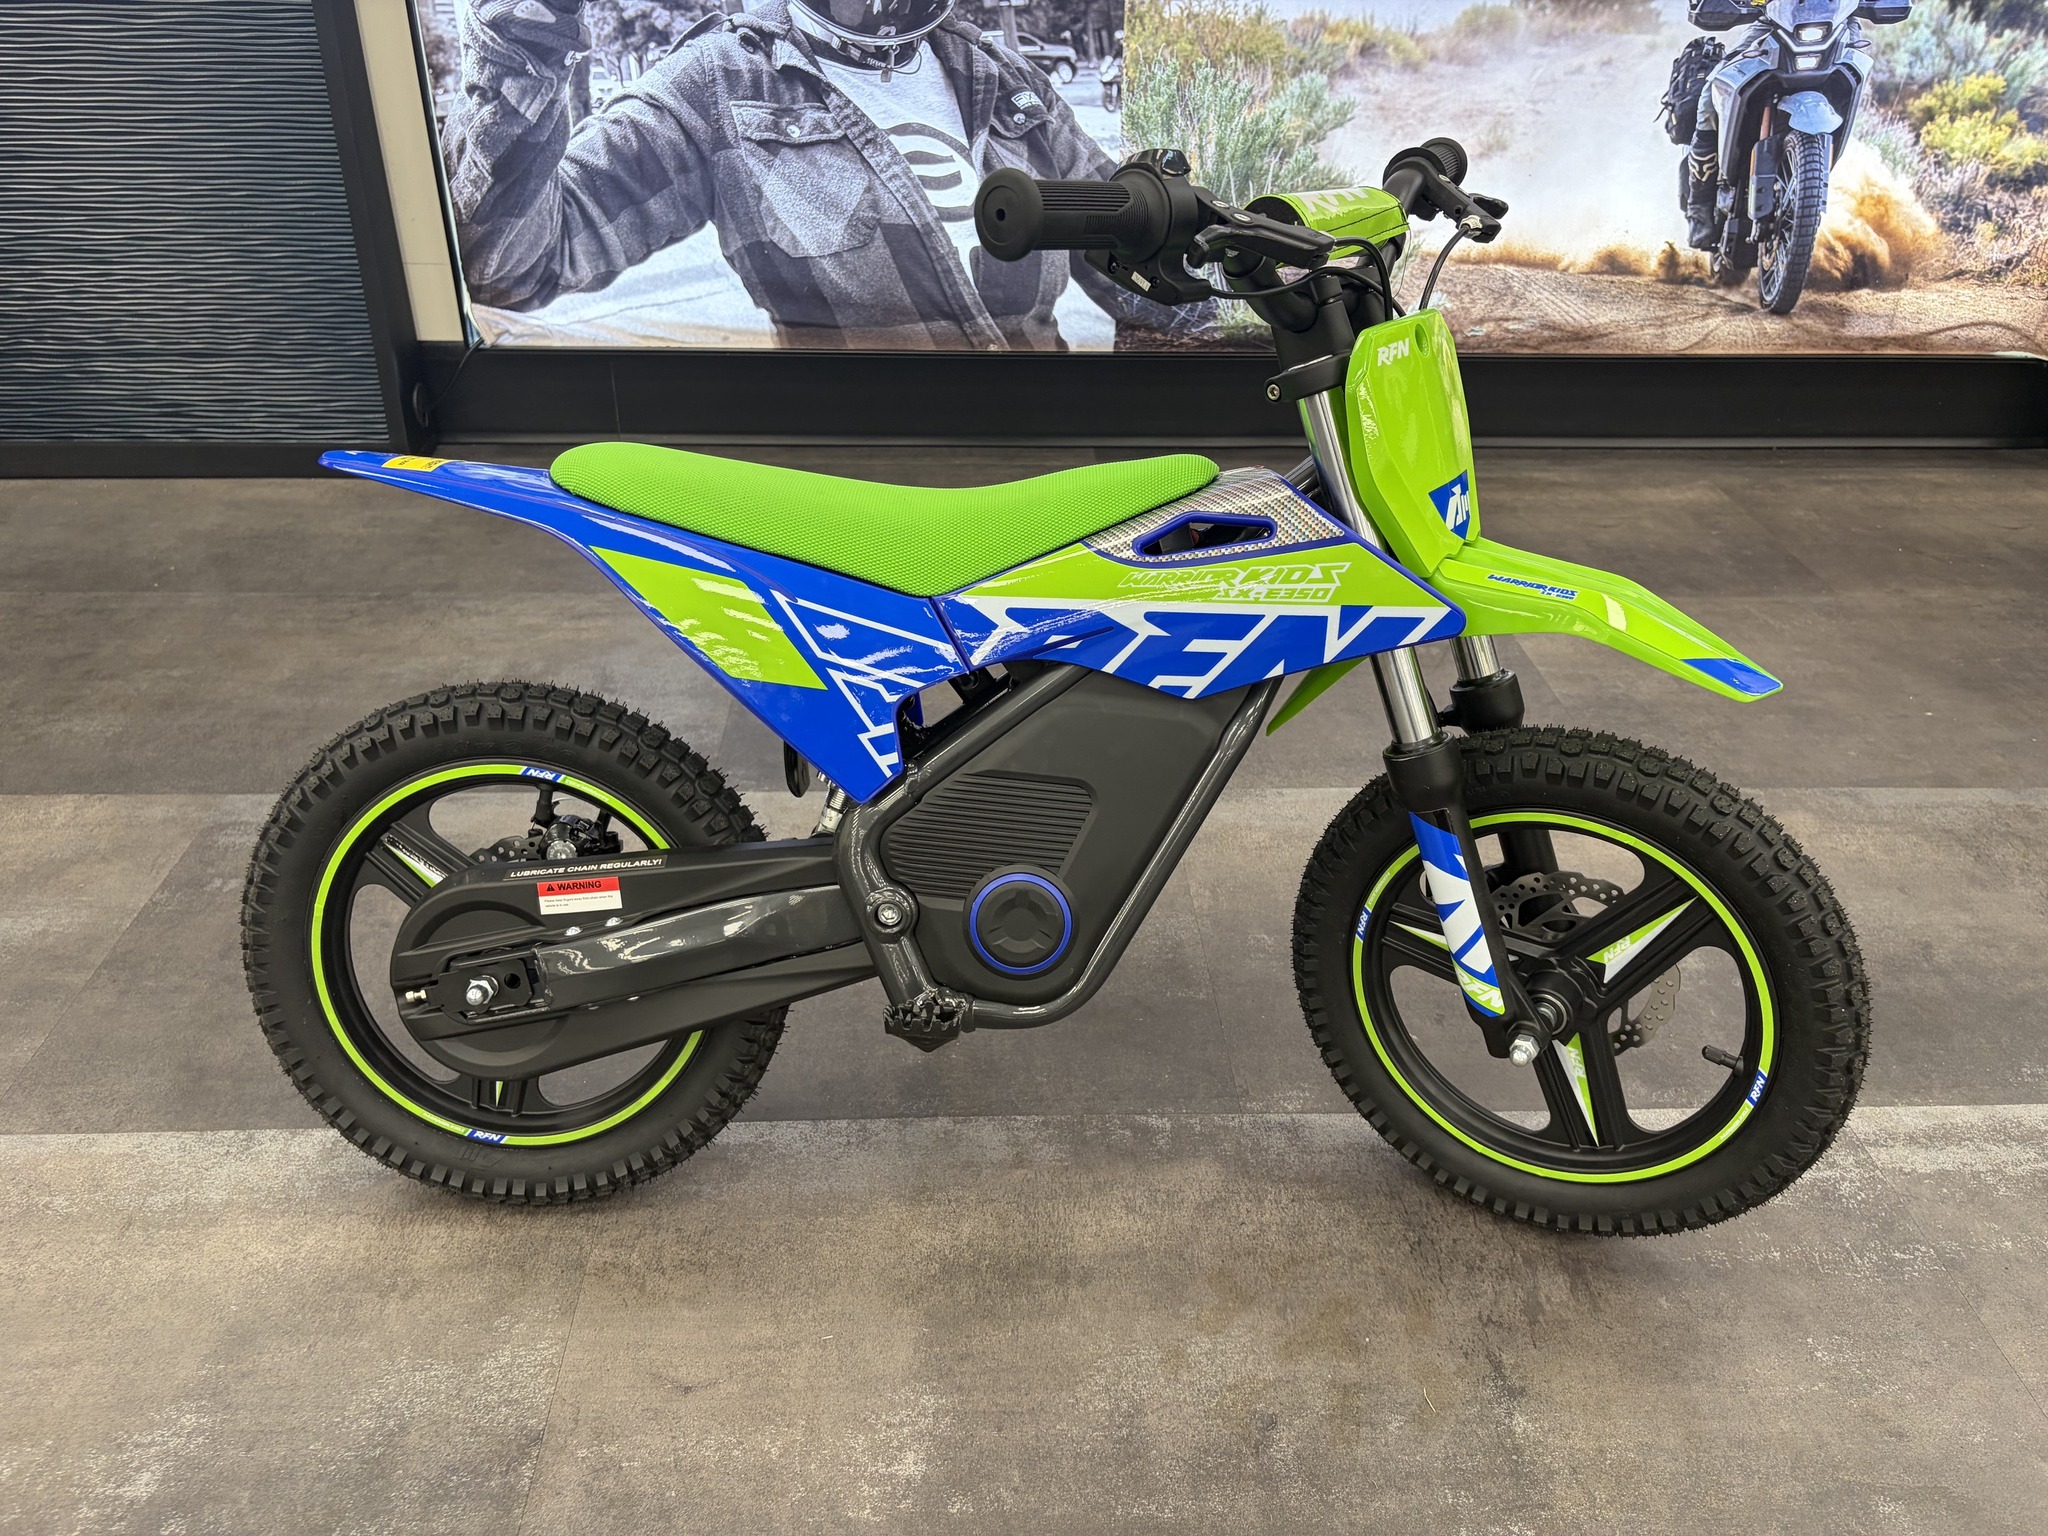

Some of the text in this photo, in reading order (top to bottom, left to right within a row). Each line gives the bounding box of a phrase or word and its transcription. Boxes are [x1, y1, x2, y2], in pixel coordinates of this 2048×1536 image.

[1377, 337, 1410, 367] RFN
[1236, 562, 1352, 587] KIDS
[1487, 574, 1579, 597] WARRIOR KIDS
[527, 767, 556, 781] RFN
[510, 858, 662, 878] LUBRICATE CHAIN REGULARLY!
[558, 880, 602, 891] WARNING
[1357, 911, 1368, 936] RFN
[1750, 1075, 1766, 1102] RFN
[473, 1130, 500, 1141] RFN
